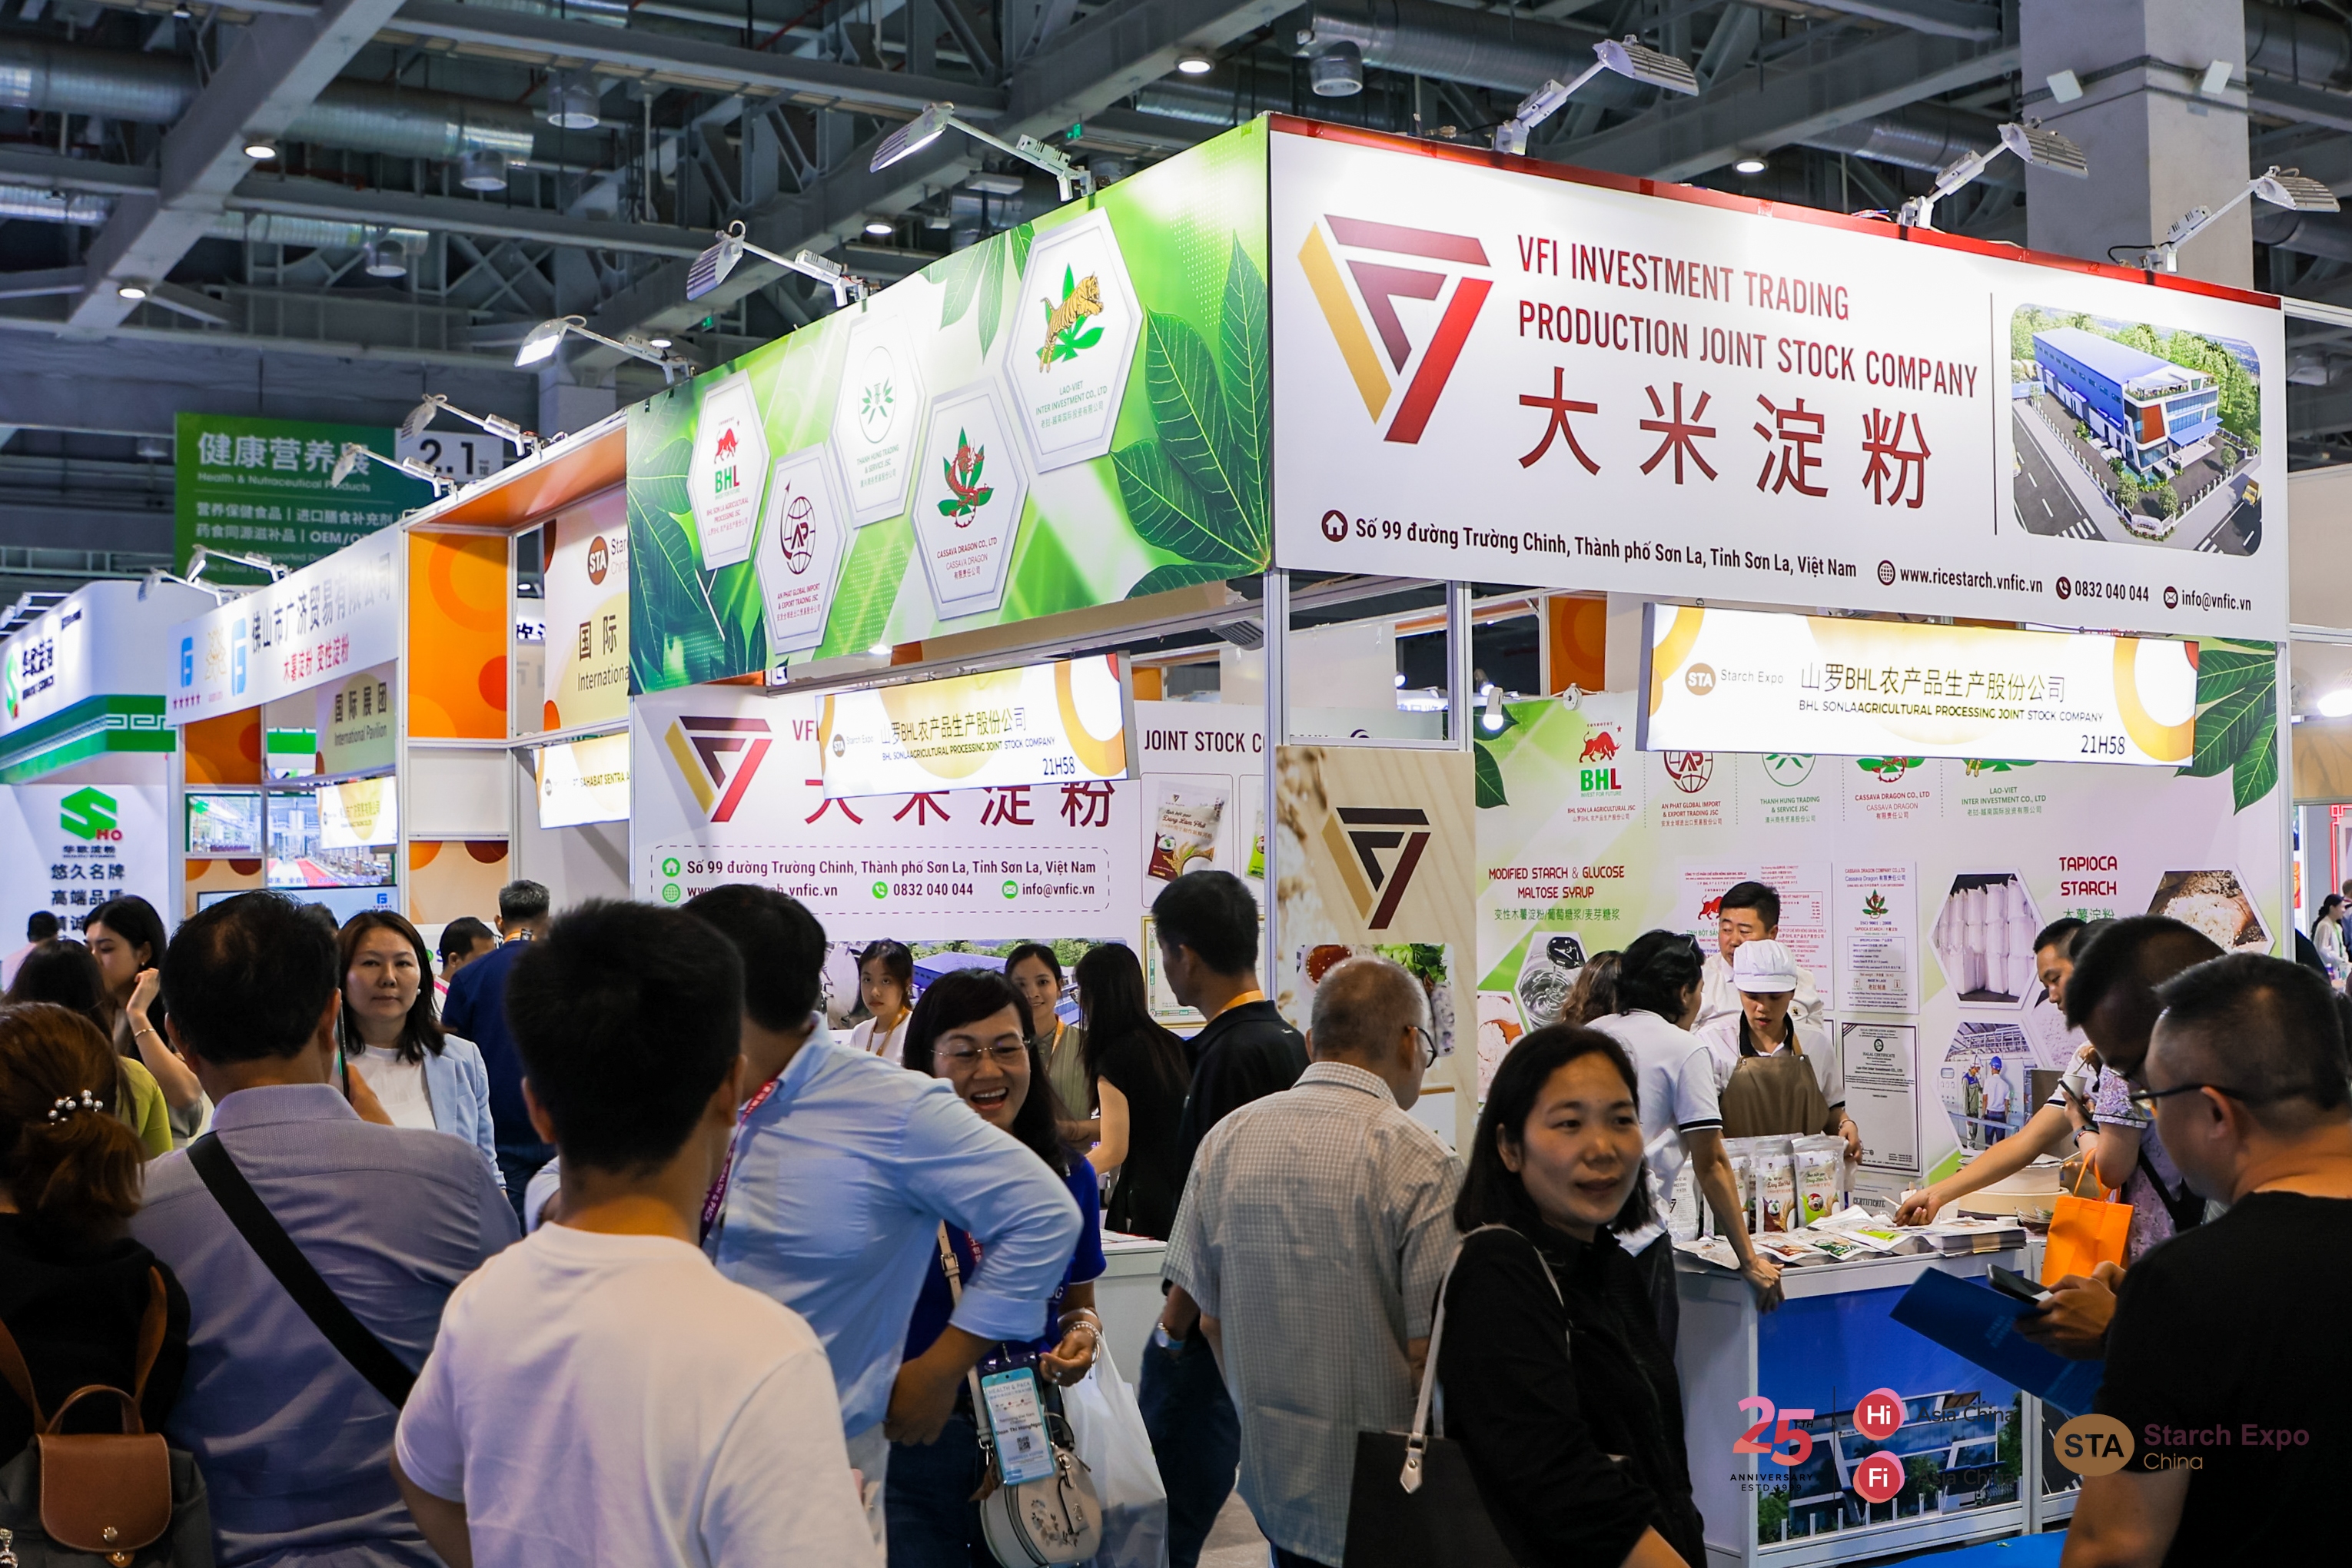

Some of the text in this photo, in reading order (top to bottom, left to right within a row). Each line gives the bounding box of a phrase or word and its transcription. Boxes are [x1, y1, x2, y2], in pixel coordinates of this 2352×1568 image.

[1517, 234, 1849, 321] VFI INVESTMENT TRADING
[1518, 300, 1978, 399] PRODUCTION JOINT STOCK COMPANY
[1059, 380, 1083, 395] LAO-VIET
[1036, 404, 1051, 415] INTER
[1051, 393, 1085, 410] INVESTMENT
[1097, 385, 1108, 396] LTD
[1517, 366, 1932, 509] 大米淀粉
[198, 431, 370, 477] 健康营养展
[420, 438, 476, 475] 2.1
[198, 472, 372, 493] Health & Nutraceutical Poducts
[715, 464, 740, 494] BHL
[196, 501, 283, 521] 营养保健食品
[611, 537, 629, 555] Star
[937, 546, 958, 559] CASSAVA
[958, 541, 978, 553] DRAGON
[988, 537, 998, 546] LTD
[589, 548, 608, 574] STA
[945, 553, 988, 570] CASSAVA DRAGON
[1355, 517, 2252, 612] Số 99 đường Trường Chinh, Thành phố Sơn La, Tỉnh Sơn La, Việt Nam www.ricestarch.vnfic.vn 0832 040 044 info@vnfic.vn
[579, 615, 618, 662] 国际
[577, 663, 630, 692] Internationa
[1688, 669, 1784, 688] STA Starch Expo
[1801, 662, 2065, 703] 山罗BHL农产品生产股份公司
[335, 681, 387, 724] 国际展团
[1799, 699, 2104, 723] BHL SONLAAGRICULTURAL PROCESSING JOINT STOCK COMPANY
[881, 706, 1027, 746] 山罗BHL农产品生产股份公司
[882, 736, 1055, 761] BHL SONLAAGRICULTURAL PROCESSING JOINT STOCK COMPANY
[1144, 729, 1188, 751] JOINT
[1195, 731, 1246, 752] STOCK
[2081, 734, 2126, 756] 21H58
[1042, 756, 1076, 776] 21H58
[604, 771, 625, 784] SENTRA
[1580, 768, 1622, 792] BHL
[1980, 796, 2020, 805] INVESTMENT
[1989, 786, 2018, 795] LAO-VIET
[51, 863, 126, 880] 悠久名牌
[687, 859, 1096, 877] Số 99 đường Trường Chinh, Thành phố Sơn La, Tỉnh Sơn La, Việt Nam
[1488, 865, 1625, 880] MODIFIED STARCH & GLUCOSE
[2058, 855, 2118, 872] TAPIOCA
[893, 882, 1095, 898] 0832 040 044 info@vnfic.vn
[1517, 886, 1594, 899] MALTOSE SYRUP
[2061, 880, 2117, 896] STARCH
[1493, 909, 1621, 921] 变性木薯淀粉/葡萄糖浆/麦芽糖浆
